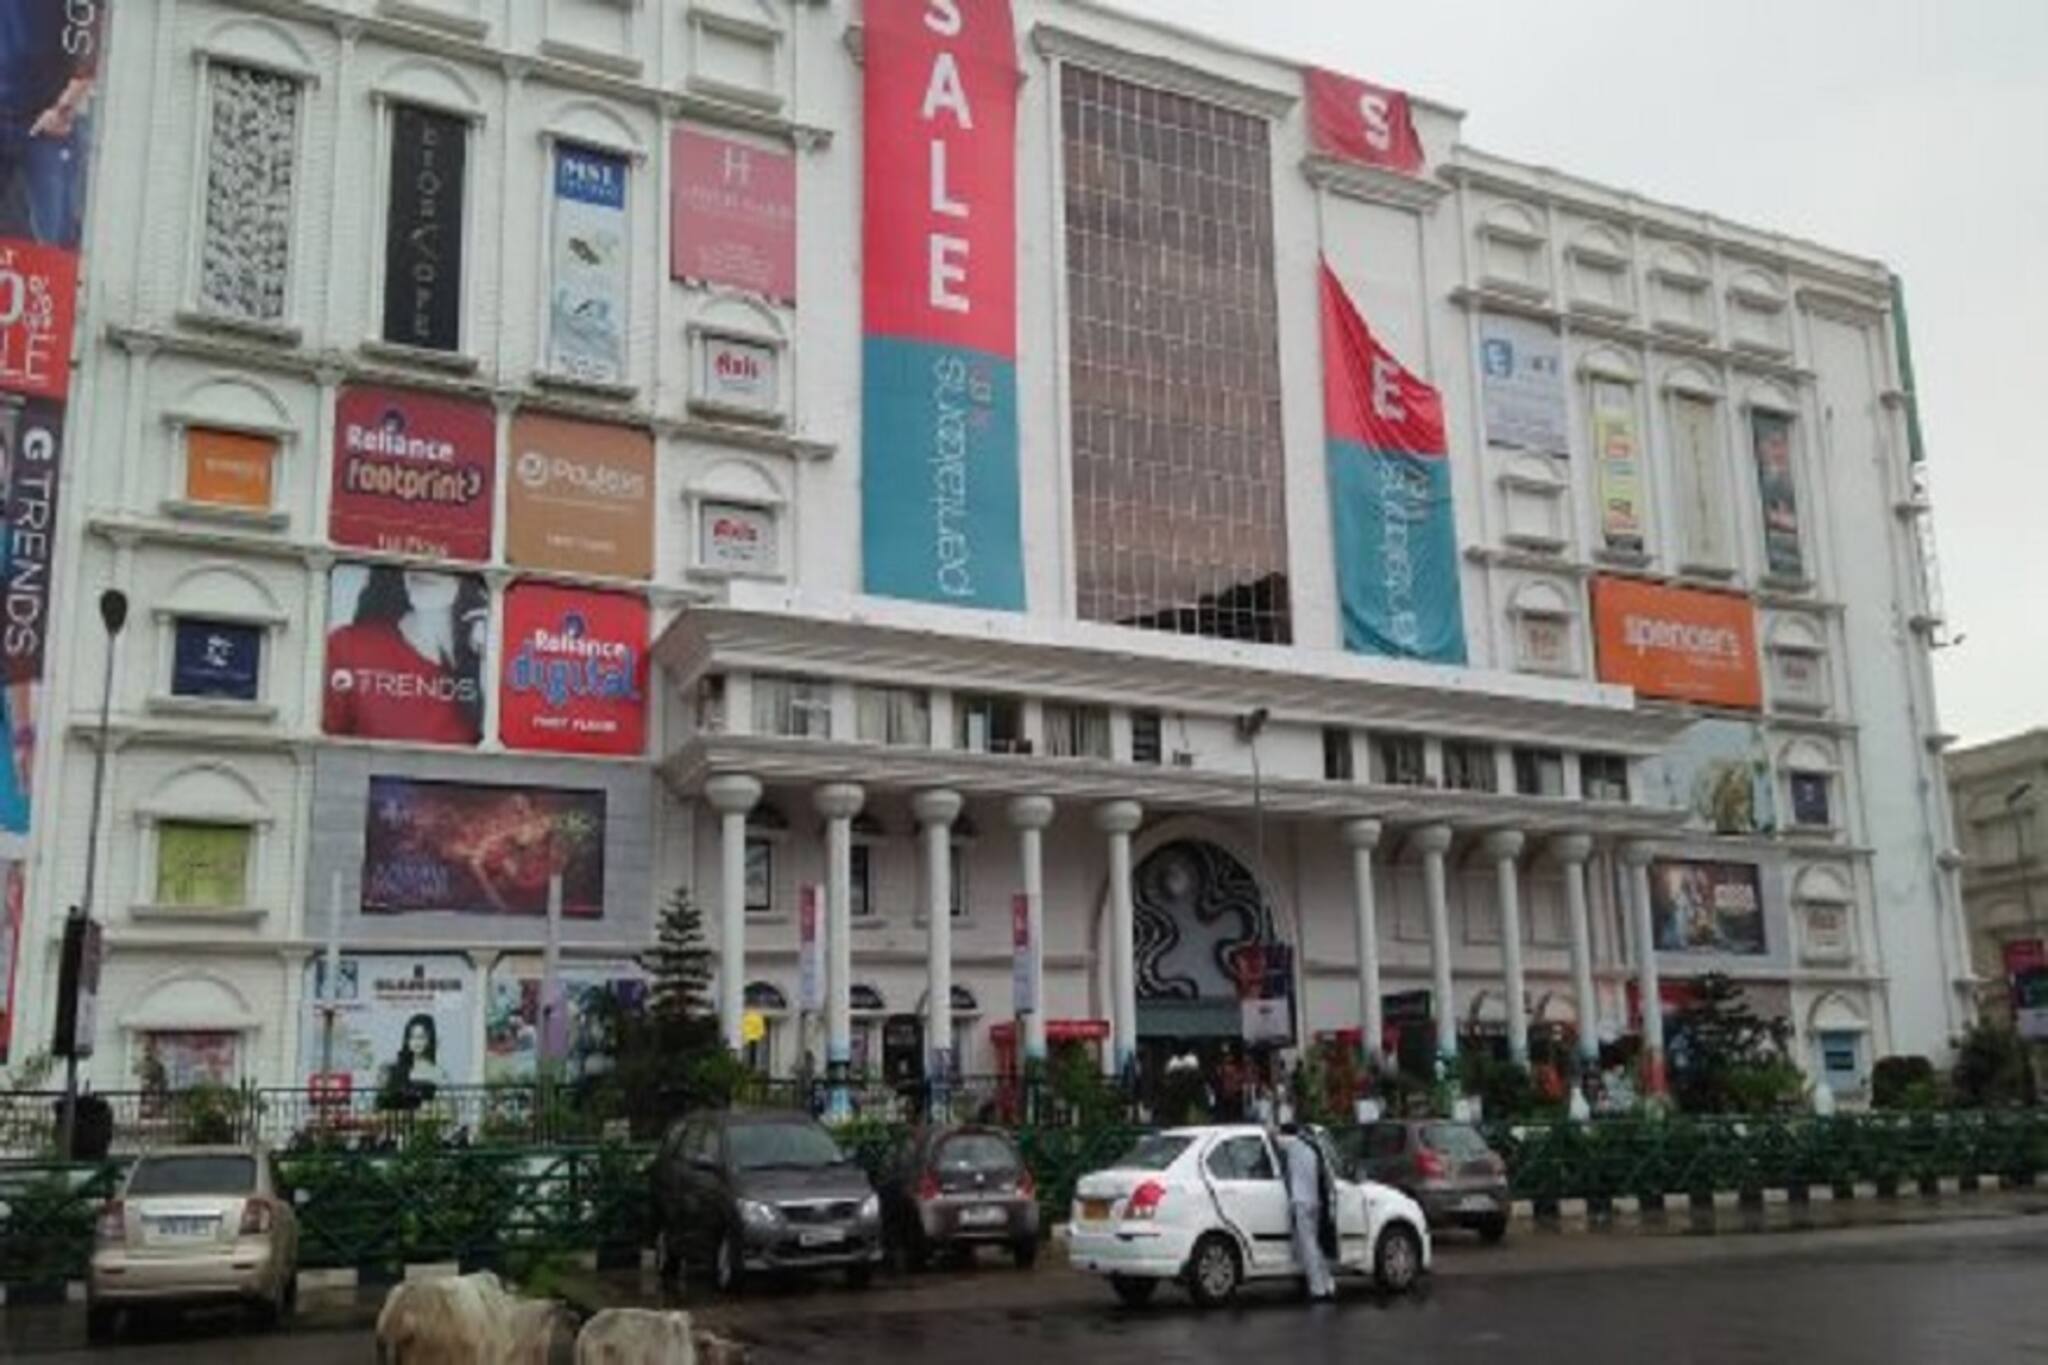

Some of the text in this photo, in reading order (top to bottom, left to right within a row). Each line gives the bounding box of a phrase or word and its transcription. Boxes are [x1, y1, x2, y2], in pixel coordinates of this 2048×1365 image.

[921, 0, 974, 315] SALE
[347, 424, 454, 464] Reliance
[930, 354, 976, 598] pantaloons
[4, 471, 52, 656] TRENDS
[511, 640, 642, 707] digital
[534, 627, 626, 657] Reliance
[356, 669, 477, 701] TRENDS
